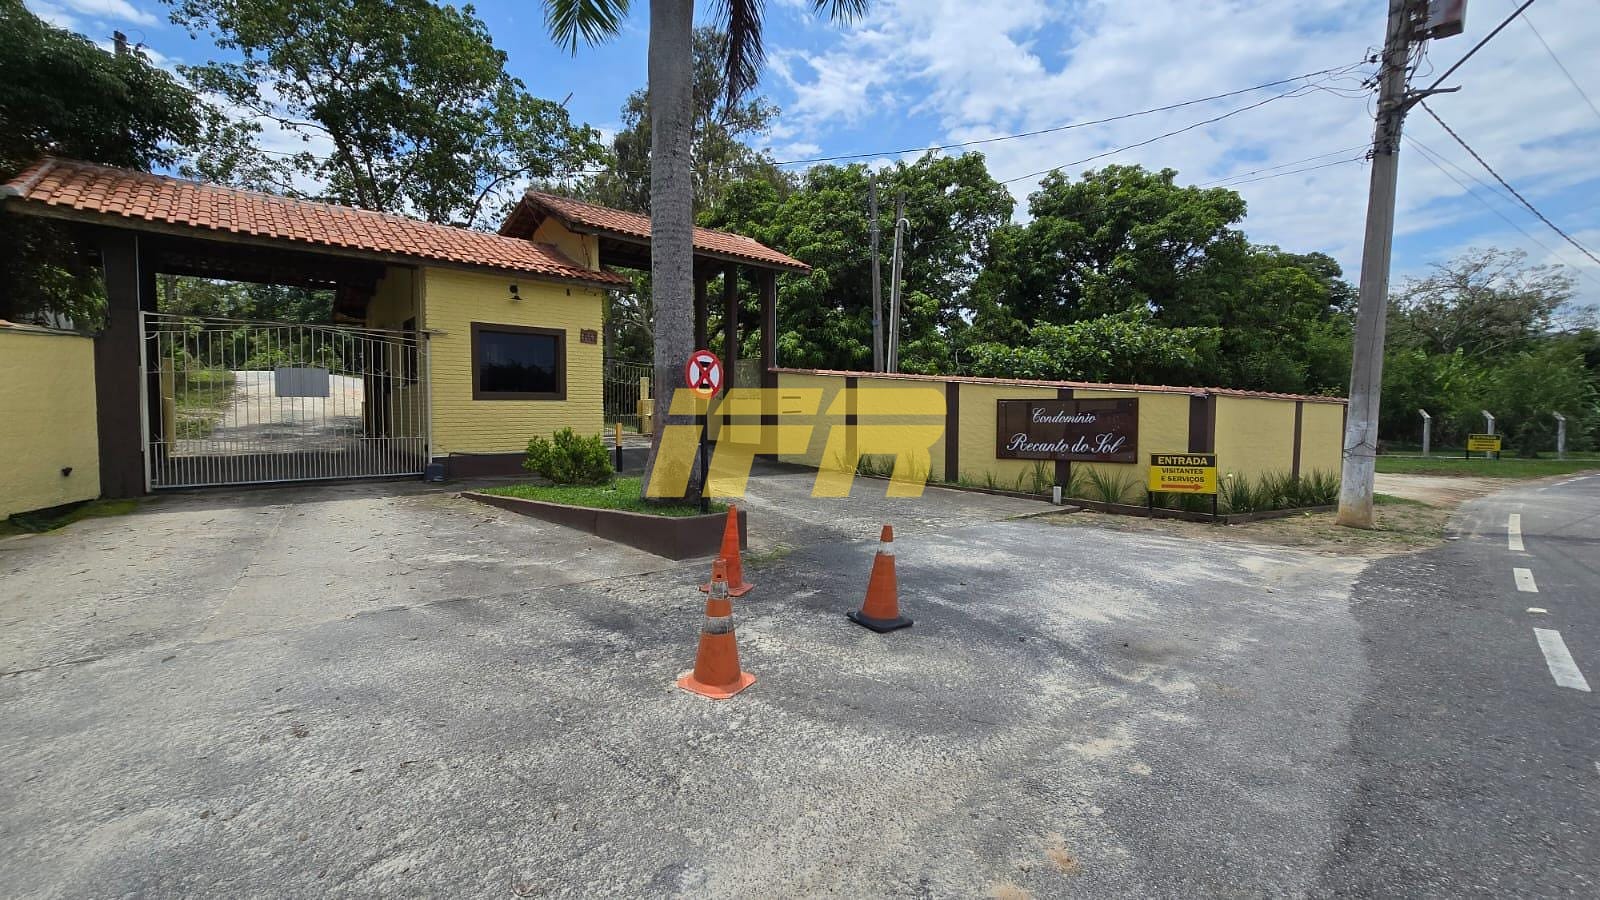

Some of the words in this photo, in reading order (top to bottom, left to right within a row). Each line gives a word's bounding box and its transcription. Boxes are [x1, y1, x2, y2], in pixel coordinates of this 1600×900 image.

[1006, 432, 1068, 452] Recanto
[1071, 435, 1089, 453] do
[1091, 432, 1126, 454] Sol
[1158, 456, 1208, 465] ENTRADA
[1161, 467, 1204, 475] VISITANTES
[1167, 475, 1205, 484] SERVIÇOS
